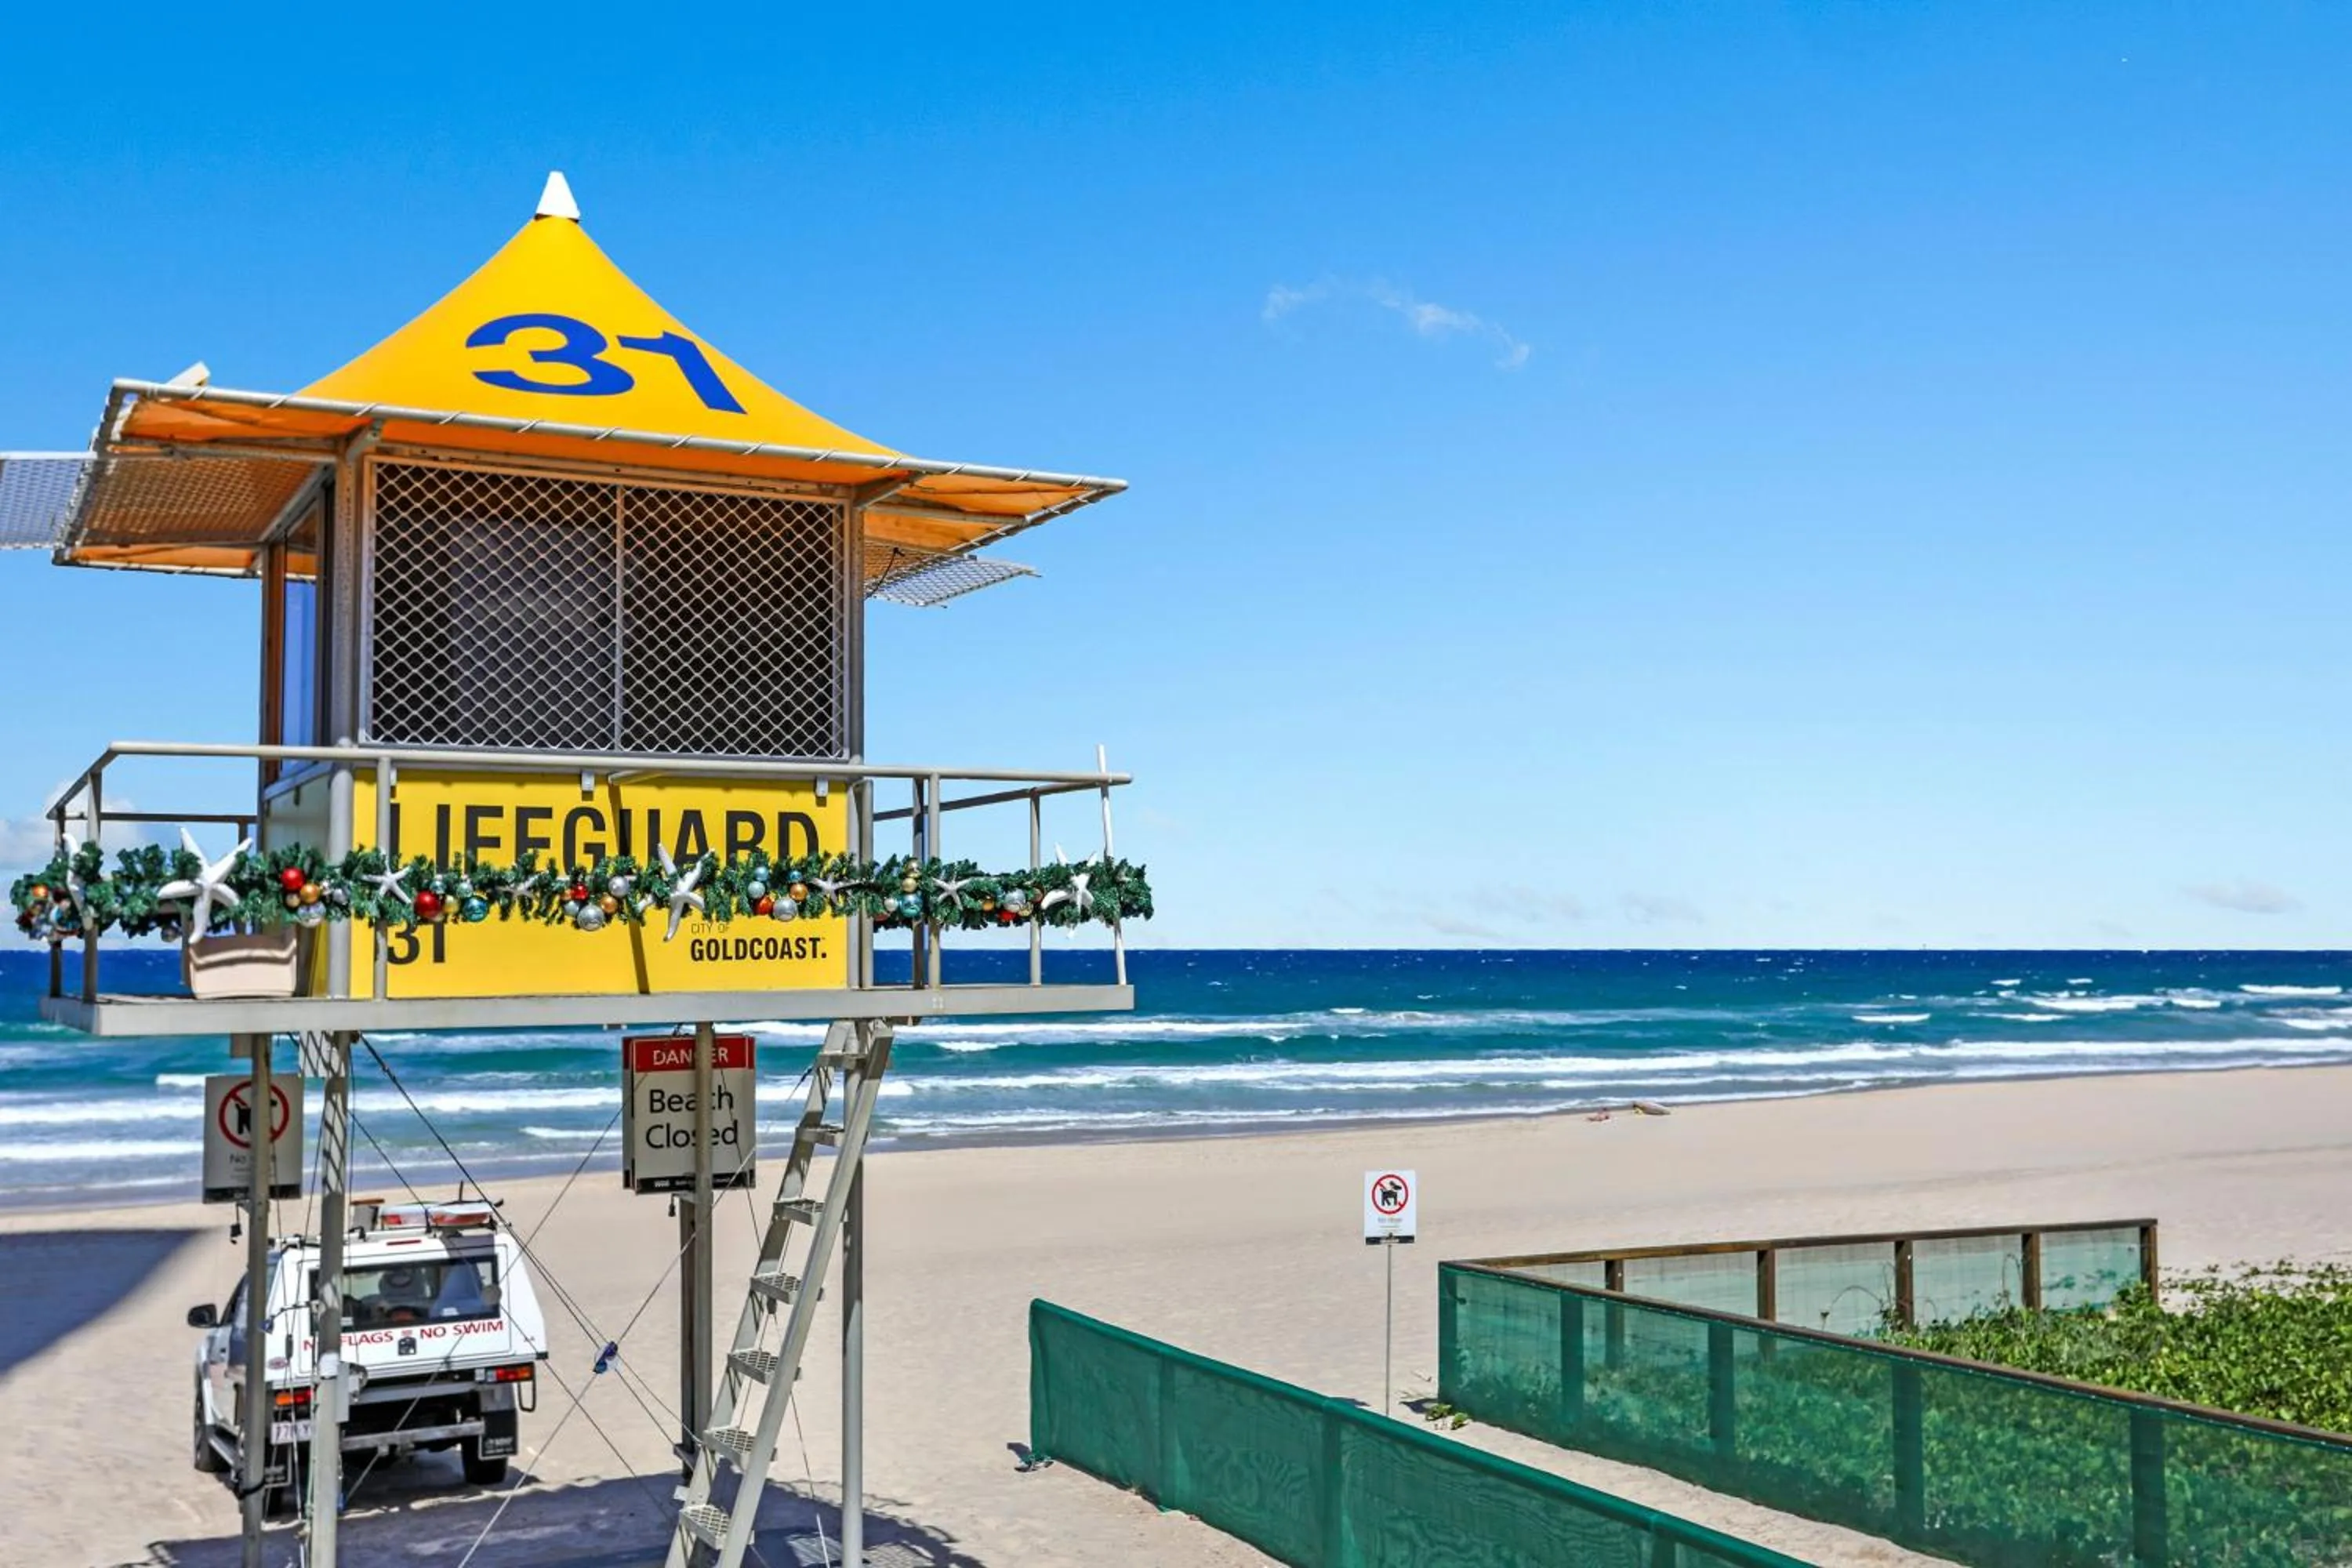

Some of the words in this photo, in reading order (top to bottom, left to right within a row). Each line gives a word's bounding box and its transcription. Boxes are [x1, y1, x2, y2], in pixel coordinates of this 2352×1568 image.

[466, 313, 747, 415] 31
[691, 923, 713, 935] CITY
[653, 1047, 729, 1065] DANER
[649, 1085, 734, 1113] Beah
[420, 1326, 446, 1339] NO
[453, 1320, 503, 1335] SWIM
